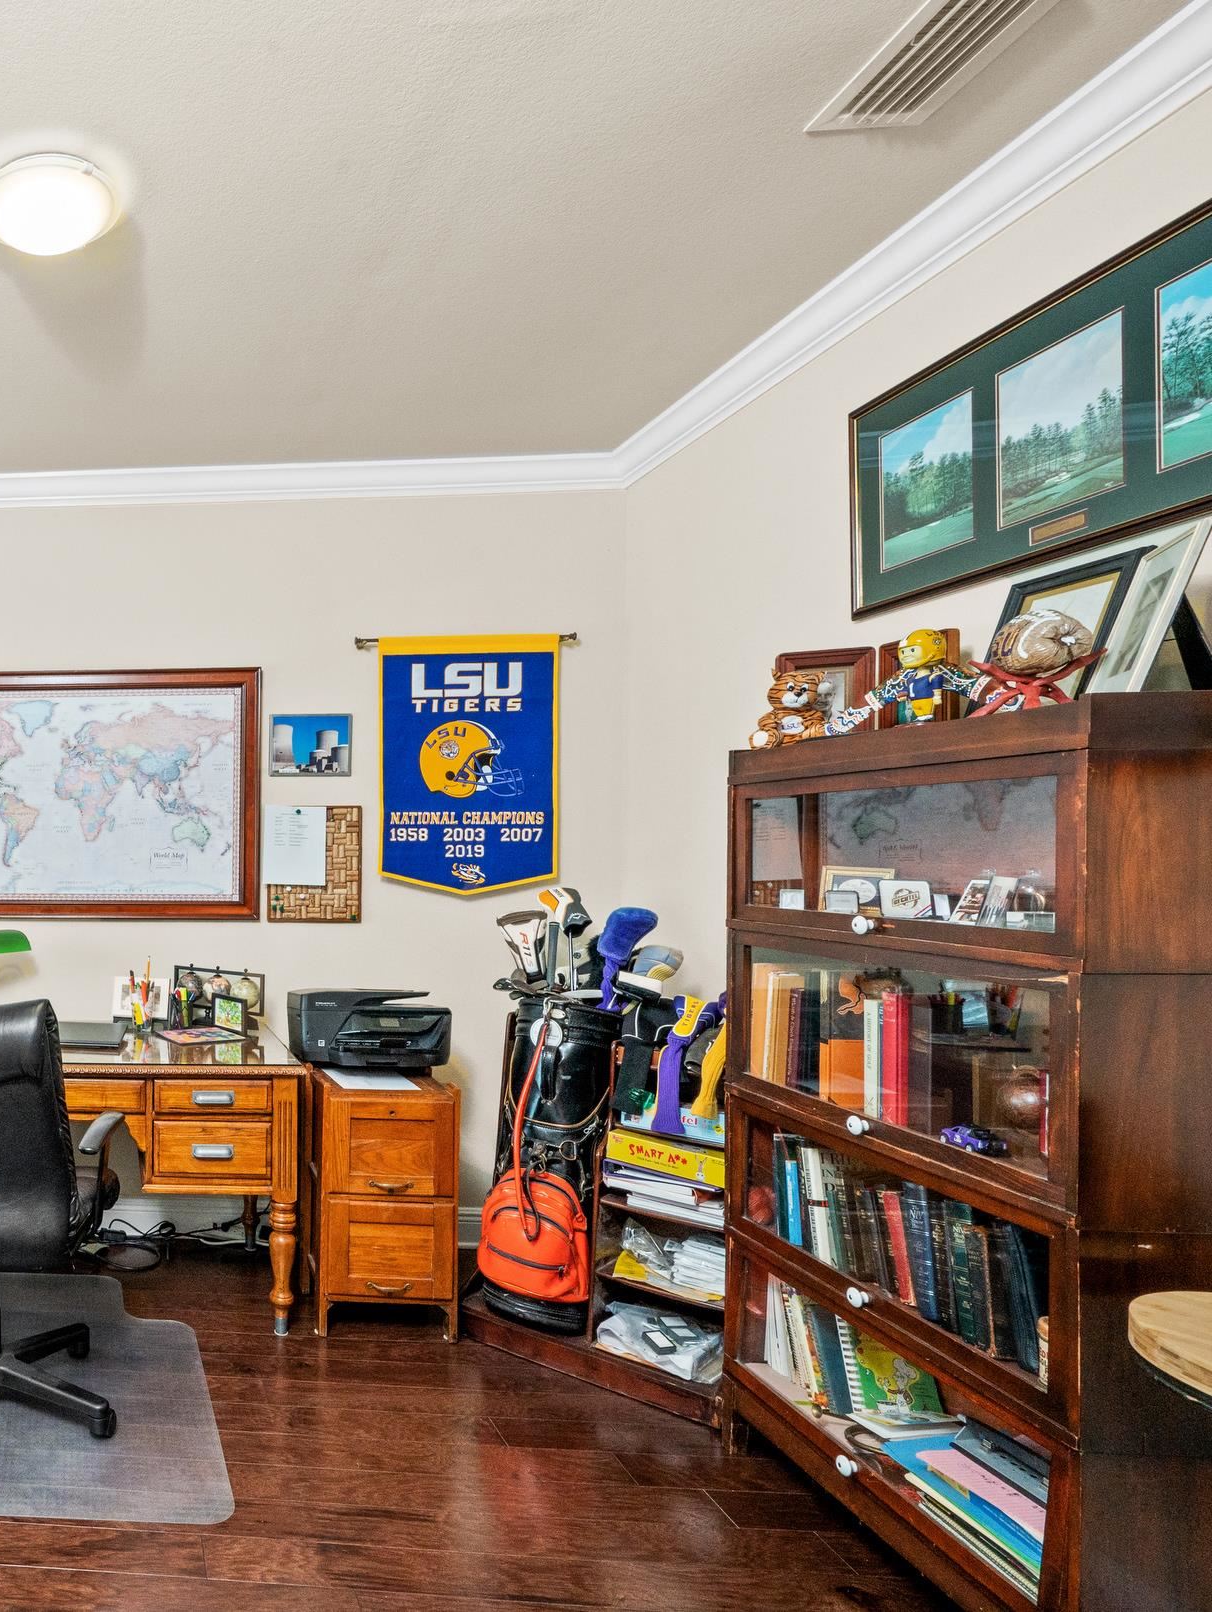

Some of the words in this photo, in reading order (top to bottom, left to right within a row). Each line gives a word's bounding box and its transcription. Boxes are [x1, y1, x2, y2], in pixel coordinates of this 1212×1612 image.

[410, 661, 523, 698] LSU
[411, 697, 522, 713] TIGERS
[780, 720, 800, 731] LSU
[425, 726, 467, 749] LSU
[390, 811, 458, 825] NATIONAL
[462, 811, 545, 825] CHAMPIONS
[389, 828, 429, 842] 1958
[443, 828, 486, 842] 2003
[500, 828, 543, 842] 2007
[444, 844, 485, 858] 2019
[682, 1115, 698, 1125] fel
[629, 1143, 664, 1160] SMART
